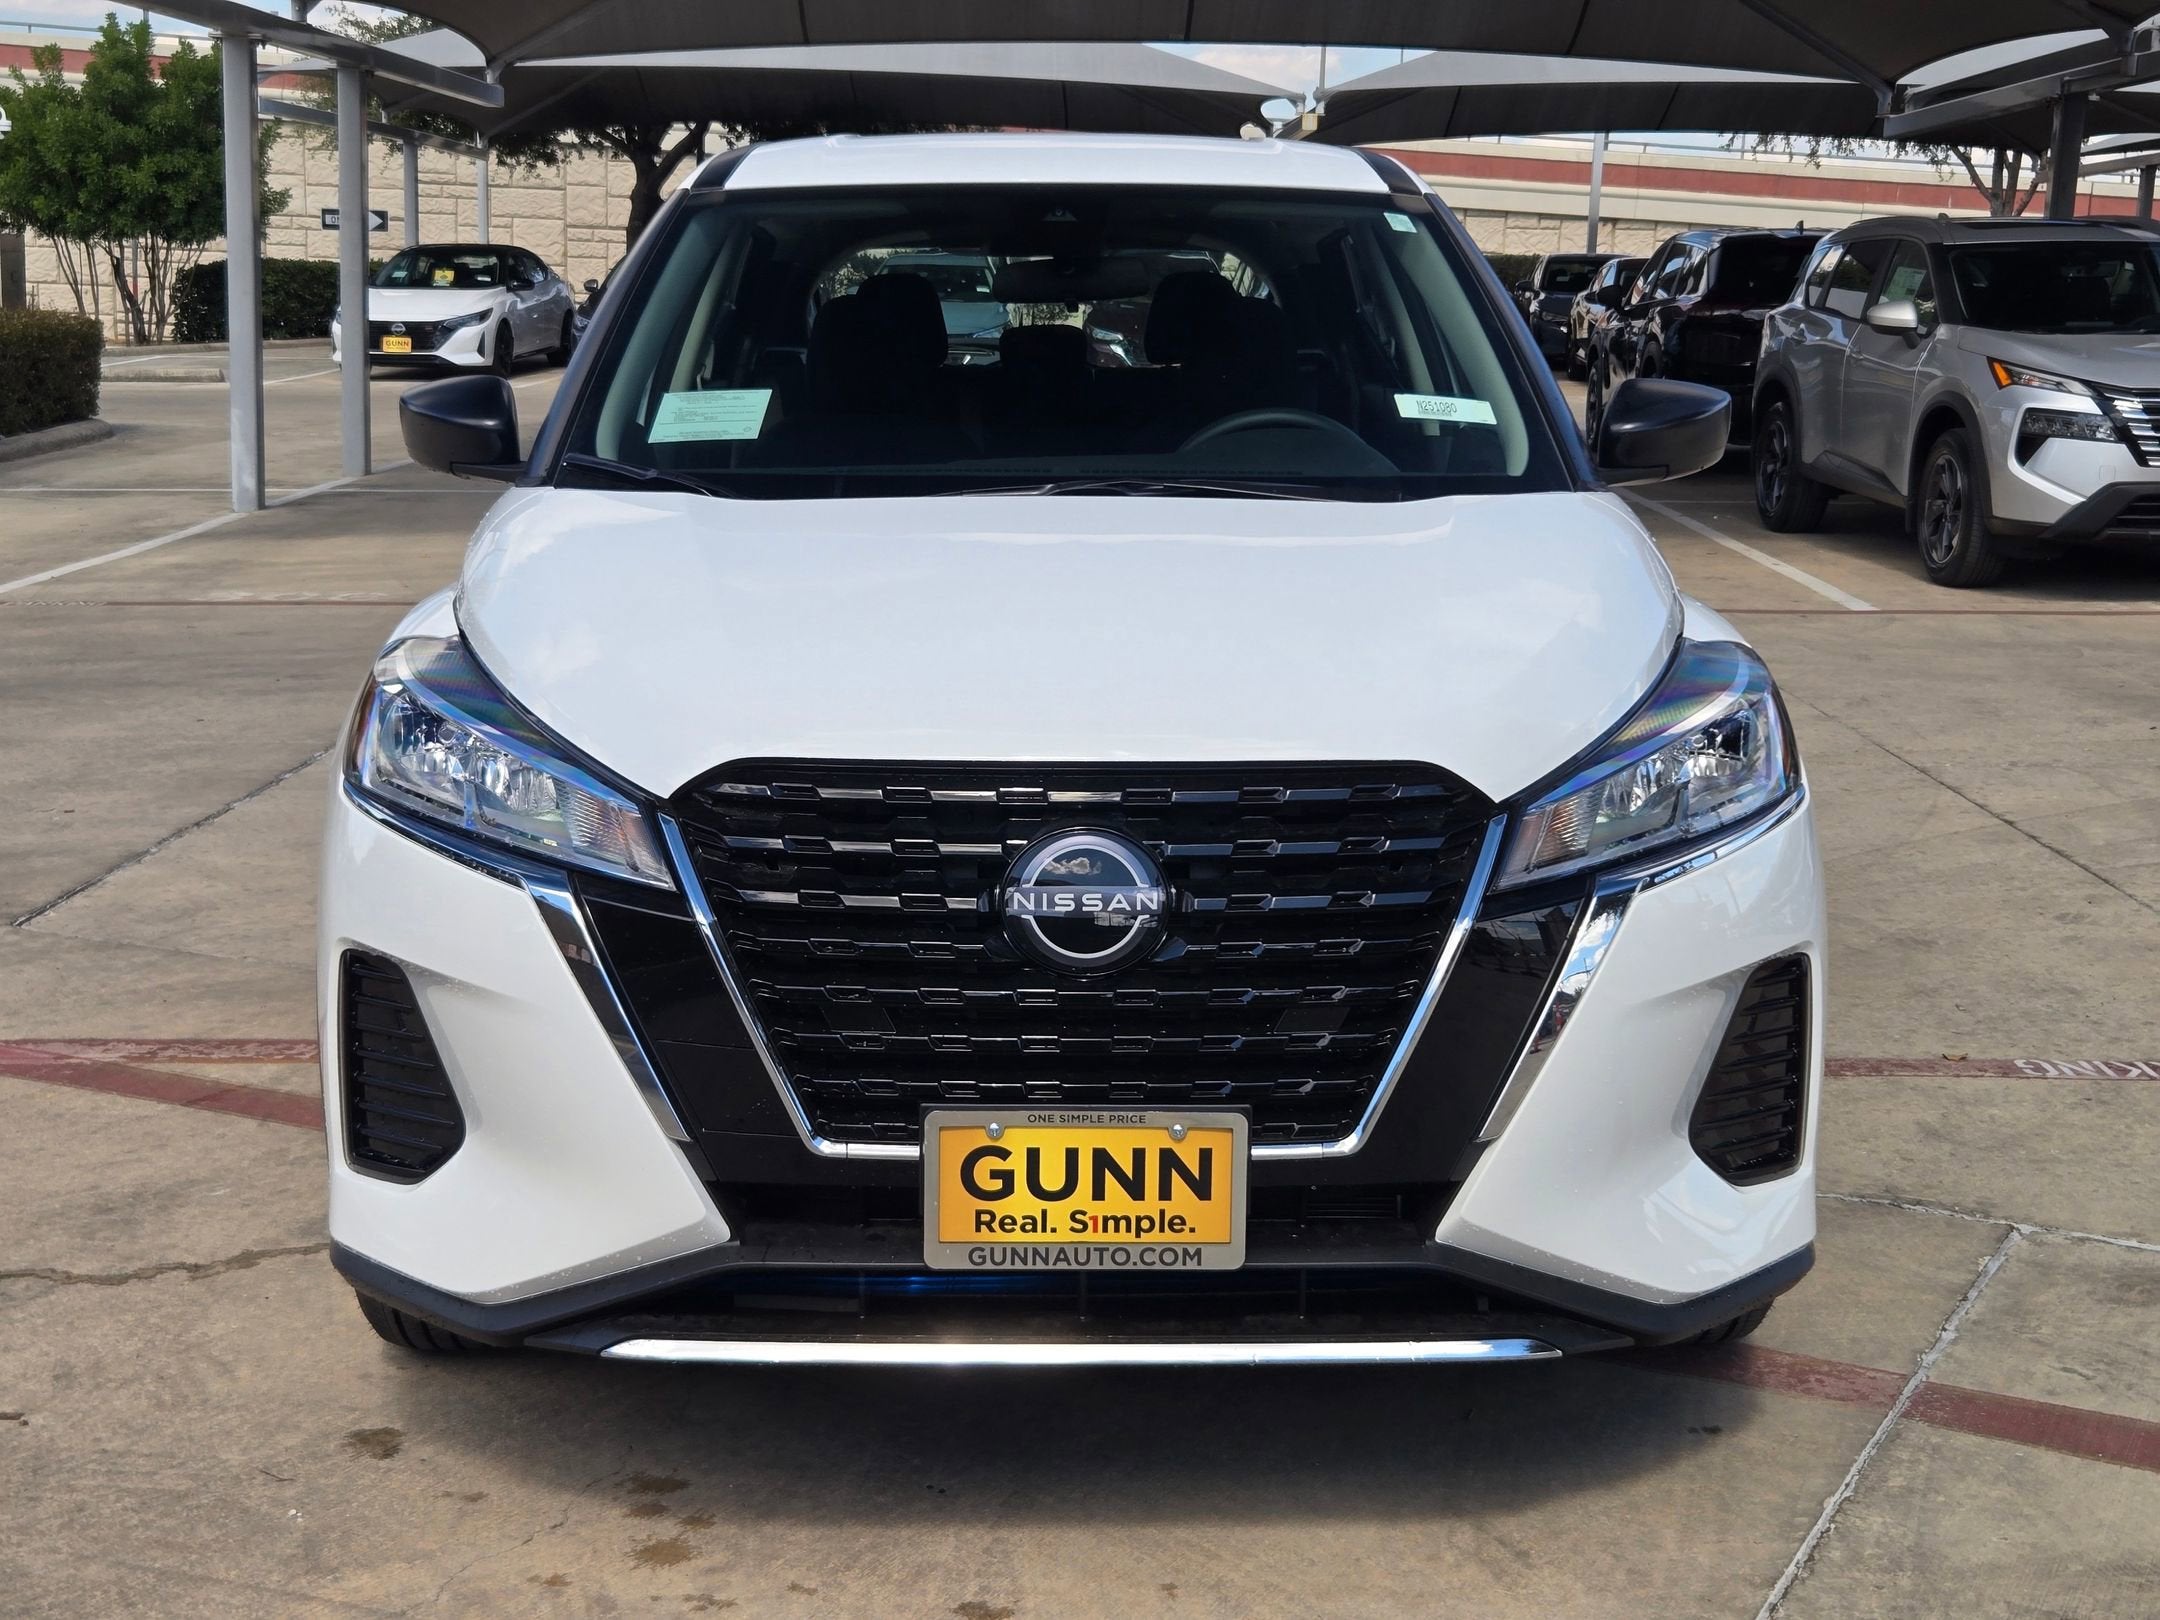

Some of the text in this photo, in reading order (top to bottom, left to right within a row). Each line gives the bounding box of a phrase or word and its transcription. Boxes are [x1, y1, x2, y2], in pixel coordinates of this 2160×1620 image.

[1416, 400, 1458, 413] N251080
[1013, 892, 1158, 912] NISSAN
[1027, 1113, 1147, 1124] ONE SIMPLE PRICE
[960, 1144, 1213, 1202] GUNN
[974, 1208, 1057, 1234] Real.
[968, 1246, 1203, 1268] GUNNAUTO.COM
